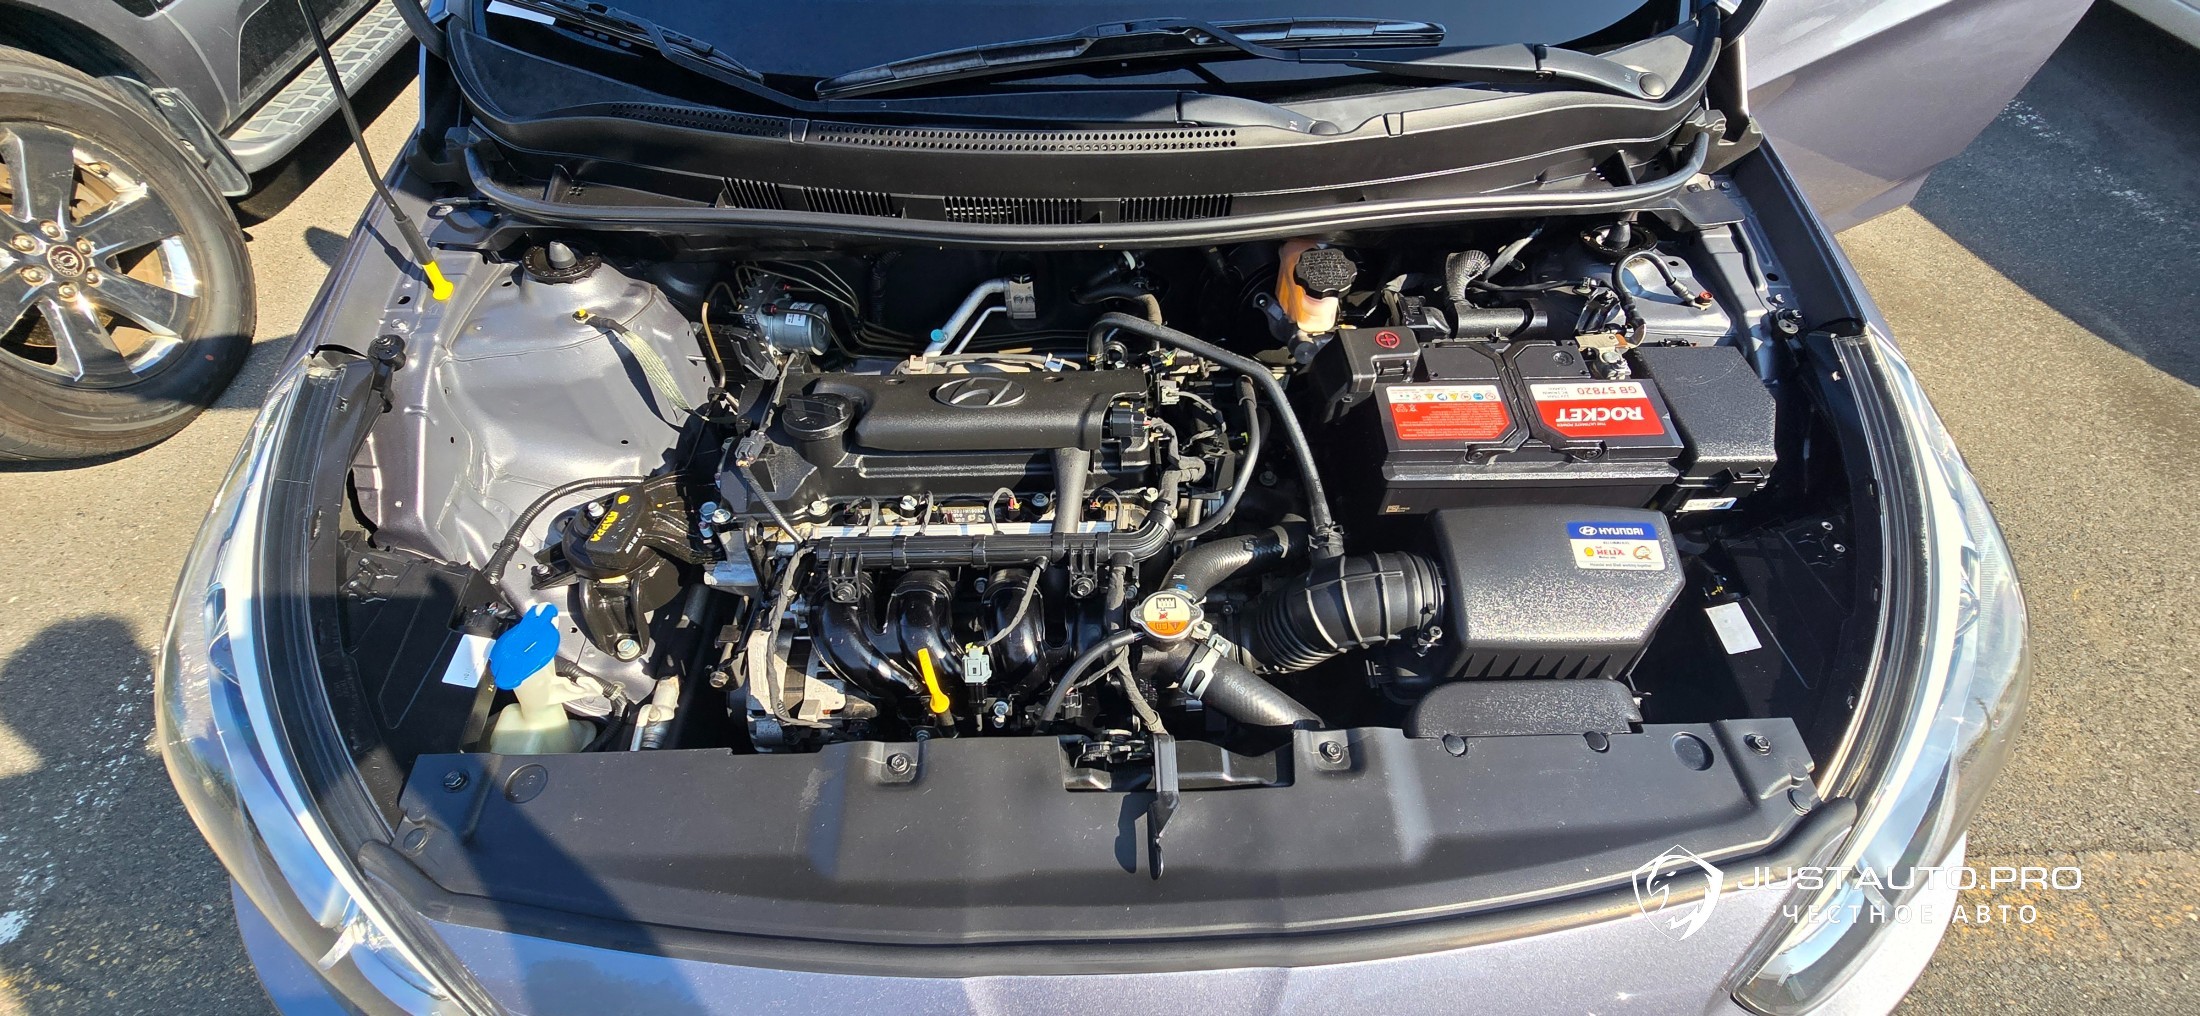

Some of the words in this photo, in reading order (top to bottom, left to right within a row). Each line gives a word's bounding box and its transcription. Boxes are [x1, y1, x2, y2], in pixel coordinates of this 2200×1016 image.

[1577, 387, 1617, 395] 57820
[1619, 386, 1637, 394] GB
[1555, 406, 1645, 422] ROCKET
[1598, 527, 1644, 536] HYUNDAI
